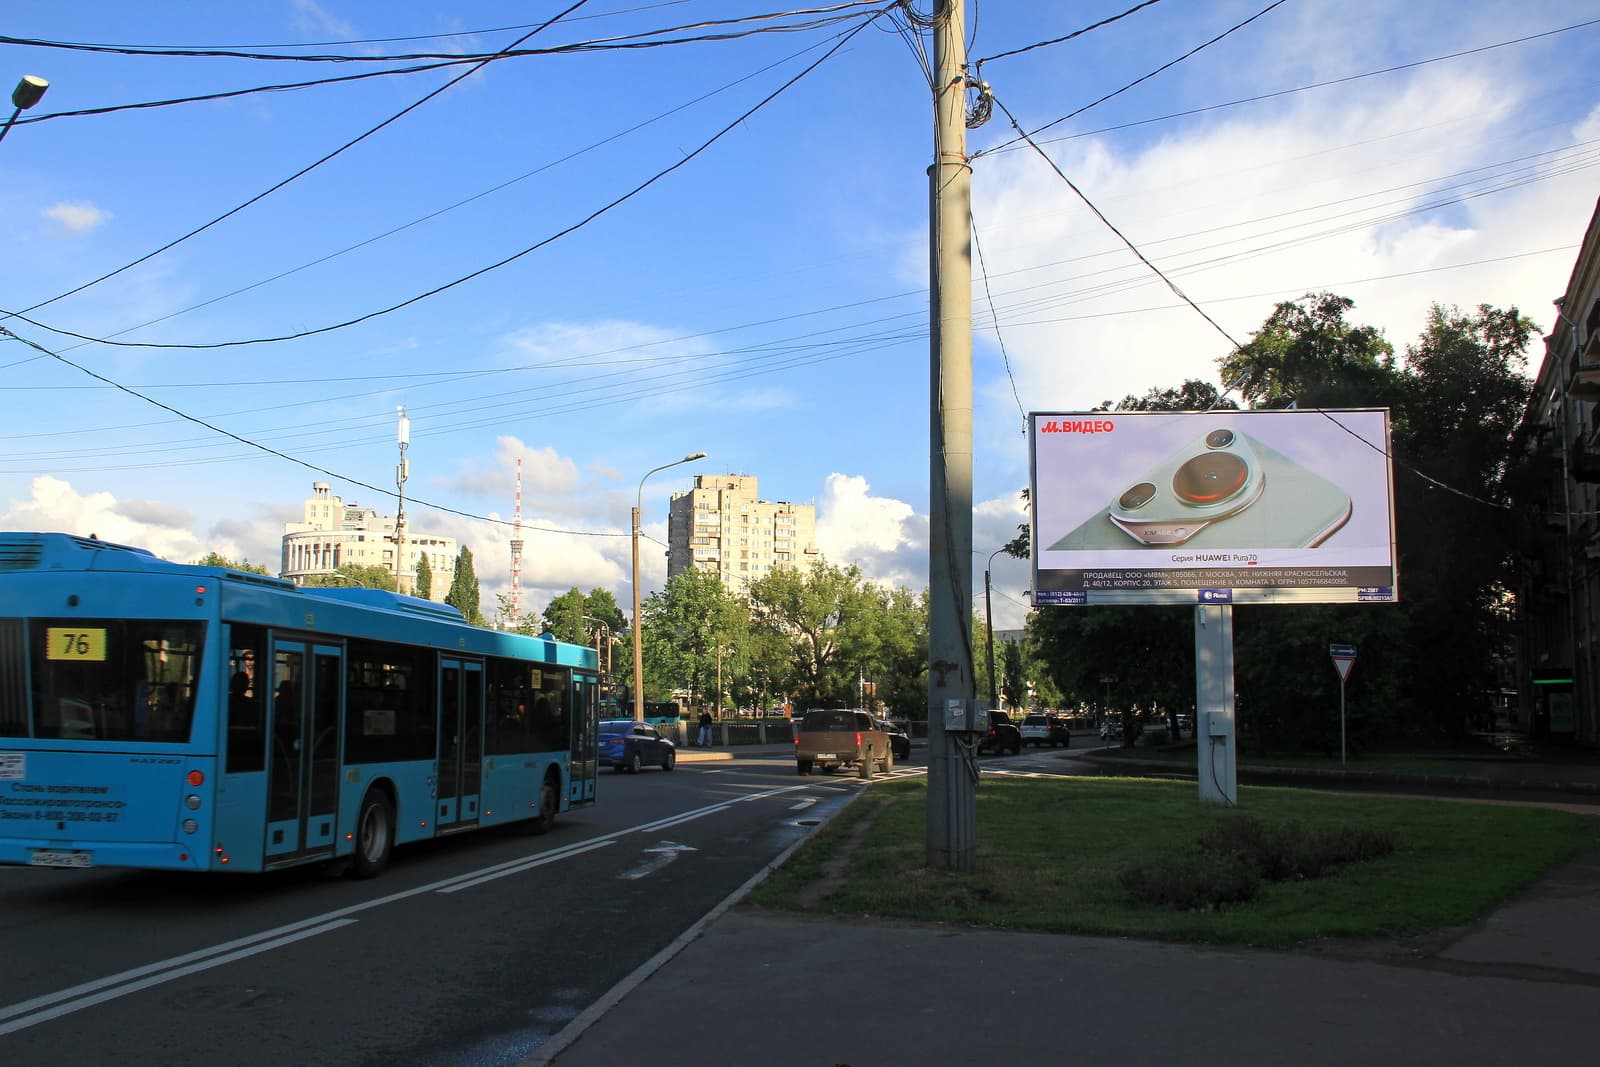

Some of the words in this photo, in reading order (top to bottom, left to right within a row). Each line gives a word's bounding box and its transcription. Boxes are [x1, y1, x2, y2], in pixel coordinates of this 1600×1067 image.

[1171, 554, 1194, 564] Серия
[1195, 554, 1231, 562] HUAWEI
[1233, 553, 1257, 562] Pura70
[1083, 572, 1122, 580] ПРОДАВЕЦ:
[1181, 579, 1226, 587] ПОМЕЩЕНИЕ
[63, 633, 89, 655] 76
[11, 782, 45, 793] Стань
[47, 785, 108, 795] водителем
